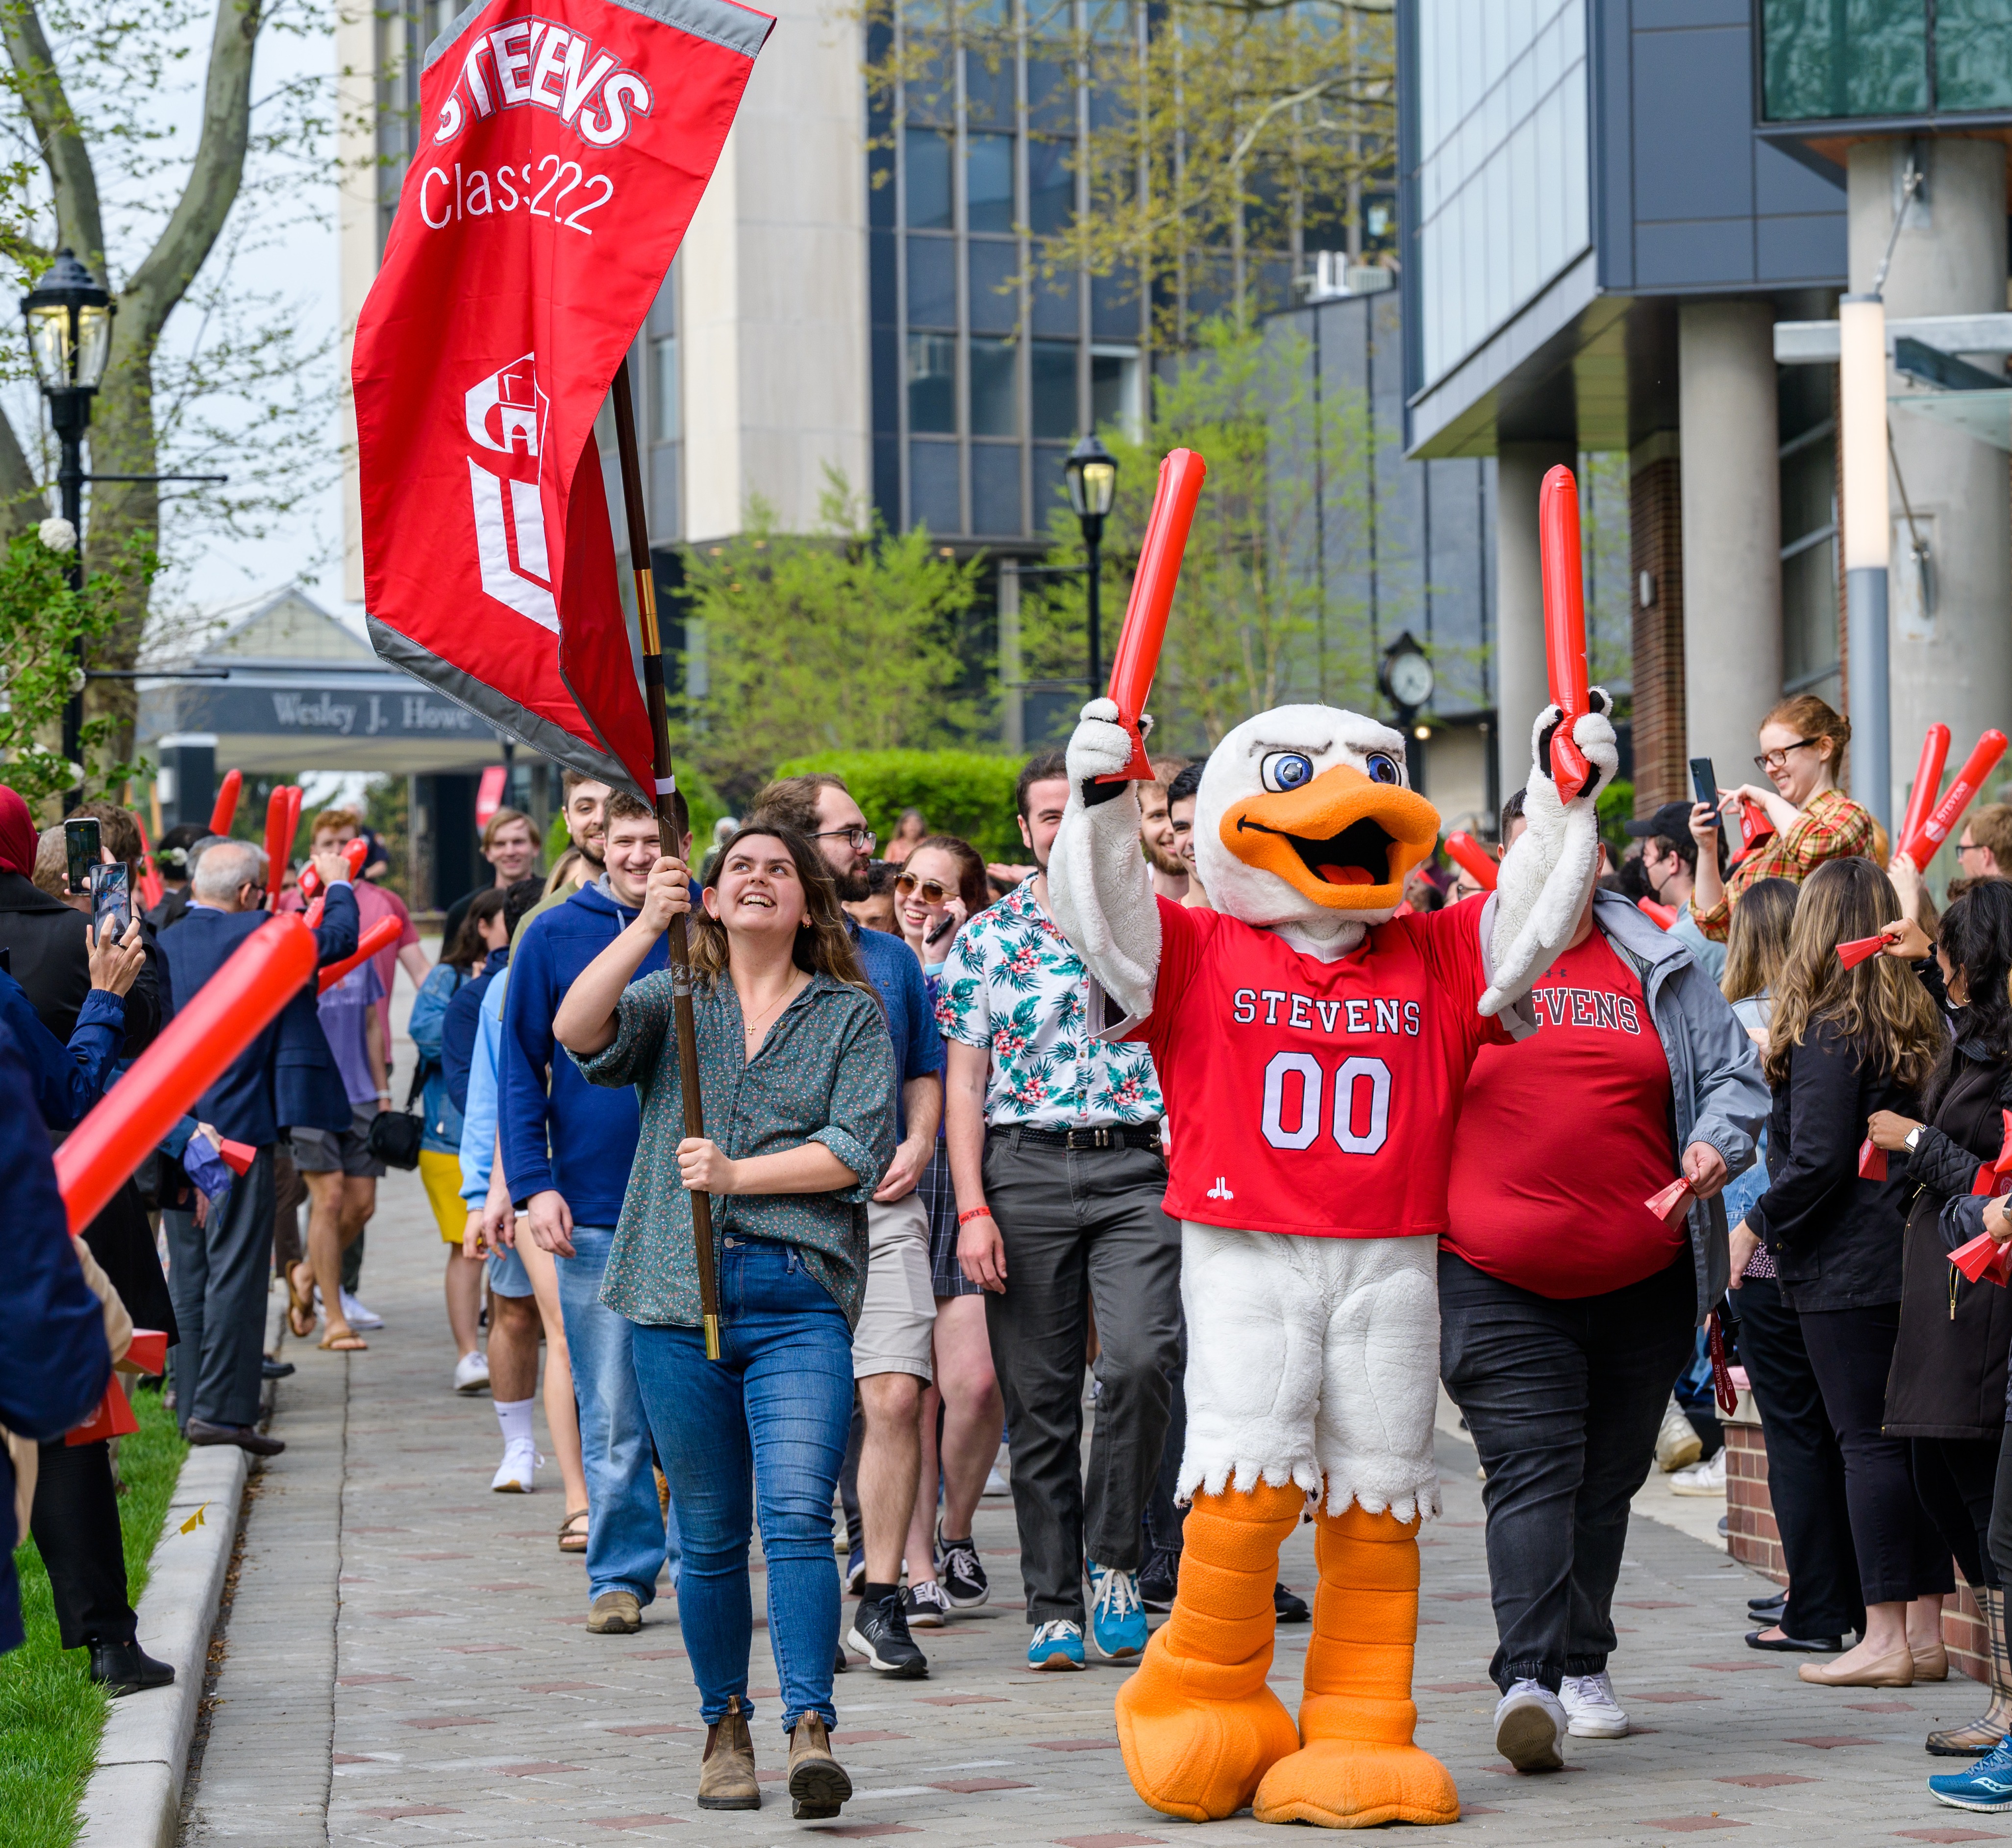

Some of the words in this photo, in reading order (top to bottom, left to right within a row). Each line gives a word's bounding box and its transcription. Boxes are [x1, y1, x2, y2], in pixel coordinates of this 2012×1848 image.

[272, 692, 357, 735] Wesley
[365, 694, 390, 735] J.
[401, 695, 472, 730] Howe
[1937, 781, 1968, 822] STEVENS
[1233, 988, 1420, 1037] STEVENS
[1260, 1051, 1393, 1155] 00
[1714, 1364, 1723, 1396] STEVENS
